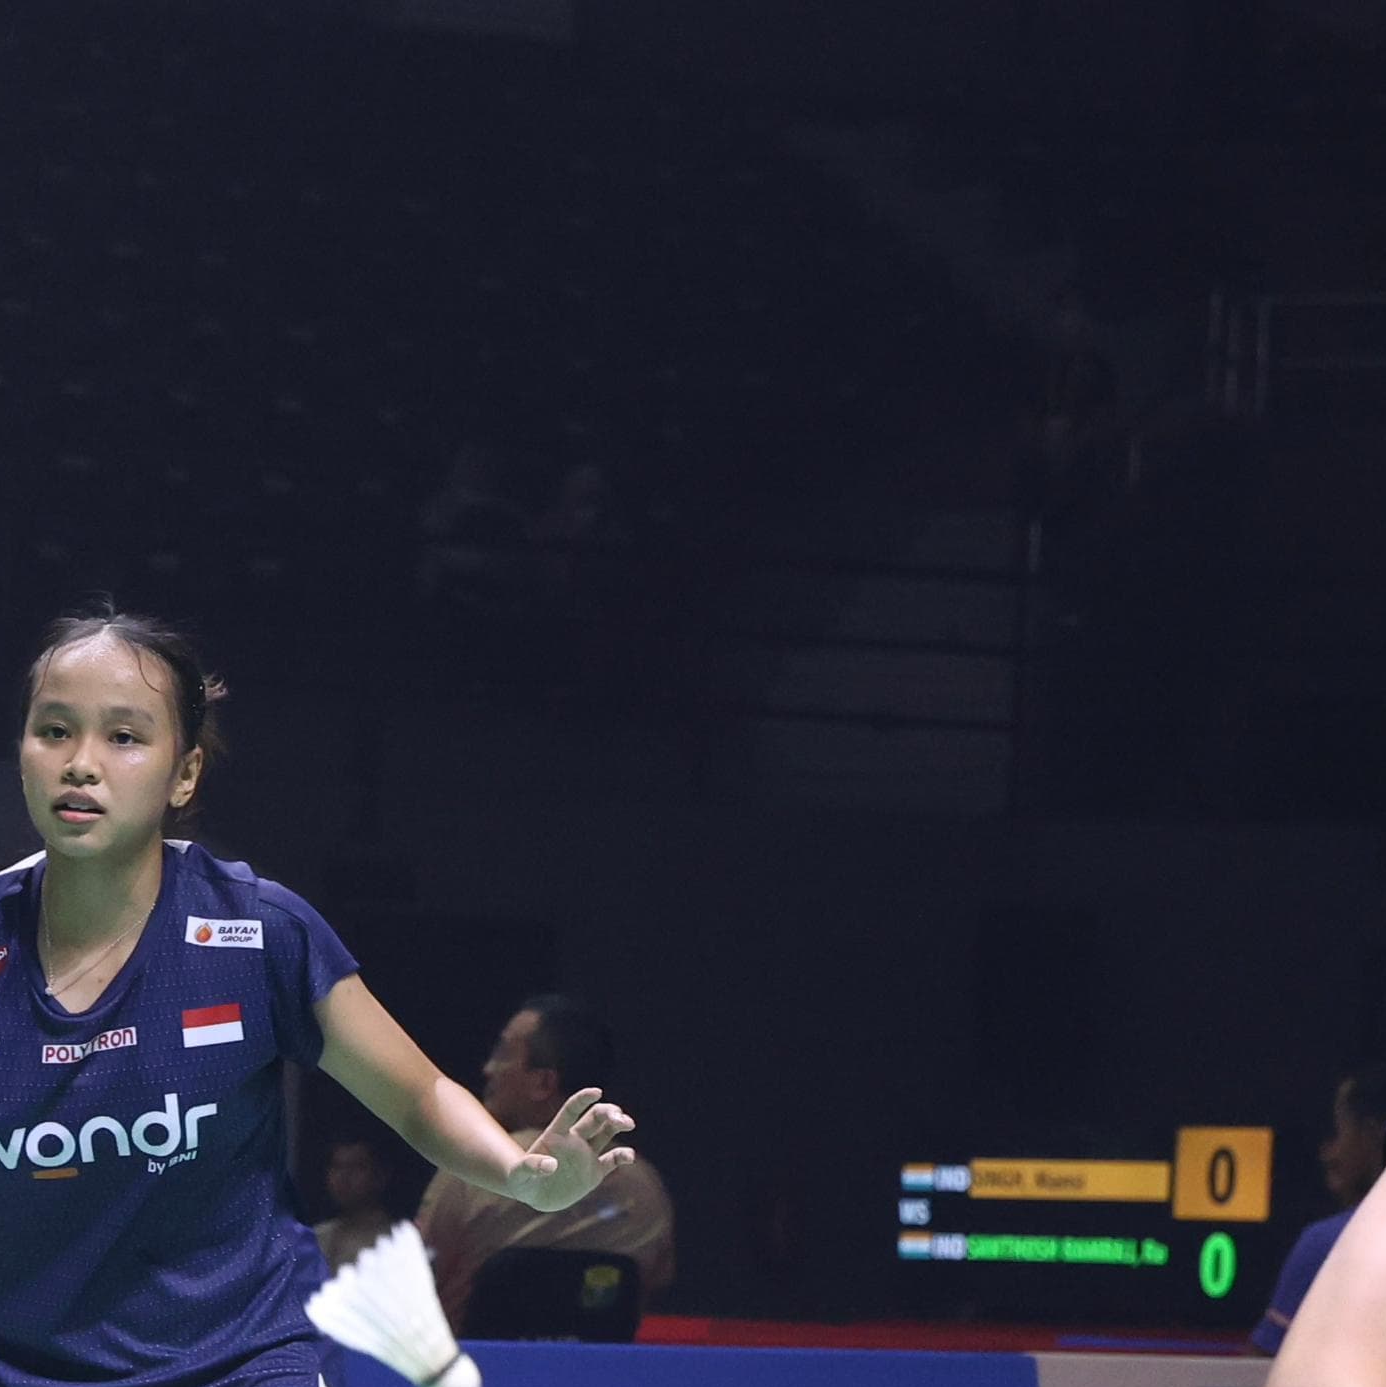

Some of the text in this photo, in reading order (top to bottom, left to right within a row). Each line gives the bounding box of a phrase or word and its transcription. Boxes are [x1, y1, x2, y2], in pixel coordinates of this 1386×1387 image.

[218, 926, 258, 935] BAYAN
[45, 1028, 134, 1062] POLYTRON
[147, 1150, 198, 1175] by BNI
[1208, 1146, 1236, 1205] 0
[1198, 1232, 1238, 1299] 0
